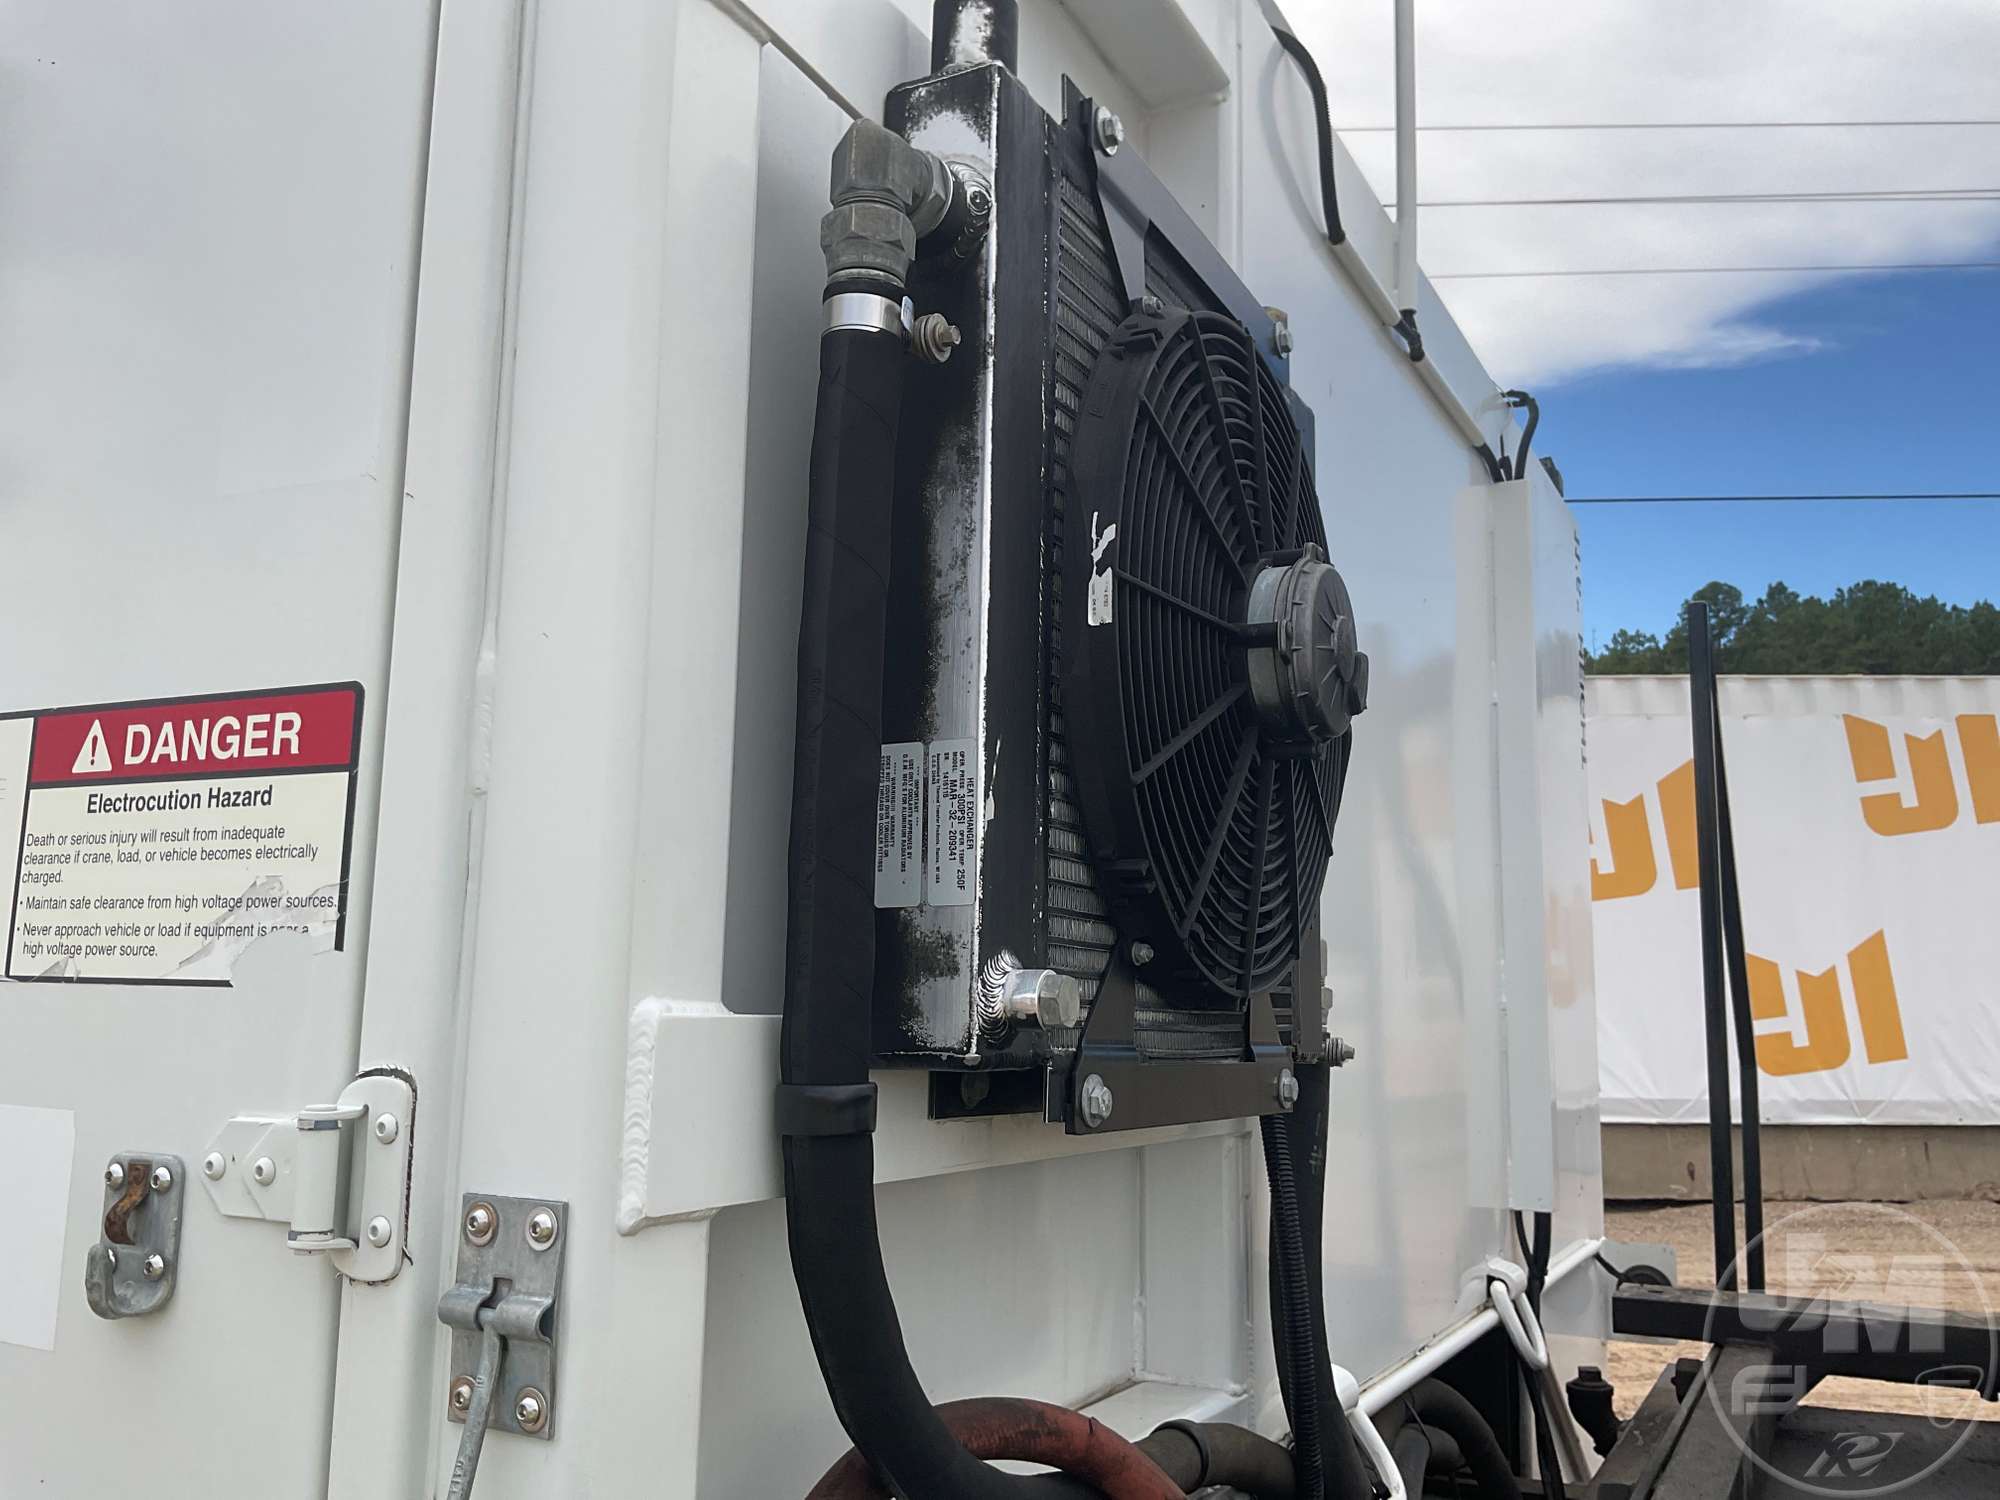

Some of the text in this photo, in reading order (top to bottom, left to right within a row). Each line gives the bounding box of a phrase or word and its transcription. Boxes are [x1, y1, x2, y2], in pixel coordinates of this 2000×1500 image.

[124, 712, 302, 765] DANGER
[87, 785, 273, 814] Electrocution Hazard
[957, 794, 965, 824] 300PSI
[27, 826, 285, 847] Death or serious injury will result from inadequate
[24, 843, 318, 866] clearance if crane, load, or vehicle becomes electrically
[22, 870, 63, 887] charged.
[957, 869, 965, 891] 250F
[26, 895, 337, 912] Maintain safe clearance from high voltage power sources.
[23, 923, 52, 937] Never
[55, 924, 101, 941] approach
[104, 923, 141, 937] vehicle
[144, 926, 155, 936] or
[158, 923, 181, 937] load
[184, 922, 191, 936] if
[194, 924, 254, 939] equipment
[257, 922, 267, 937] is
[23, 943, 157, 959] high voltage power source.
